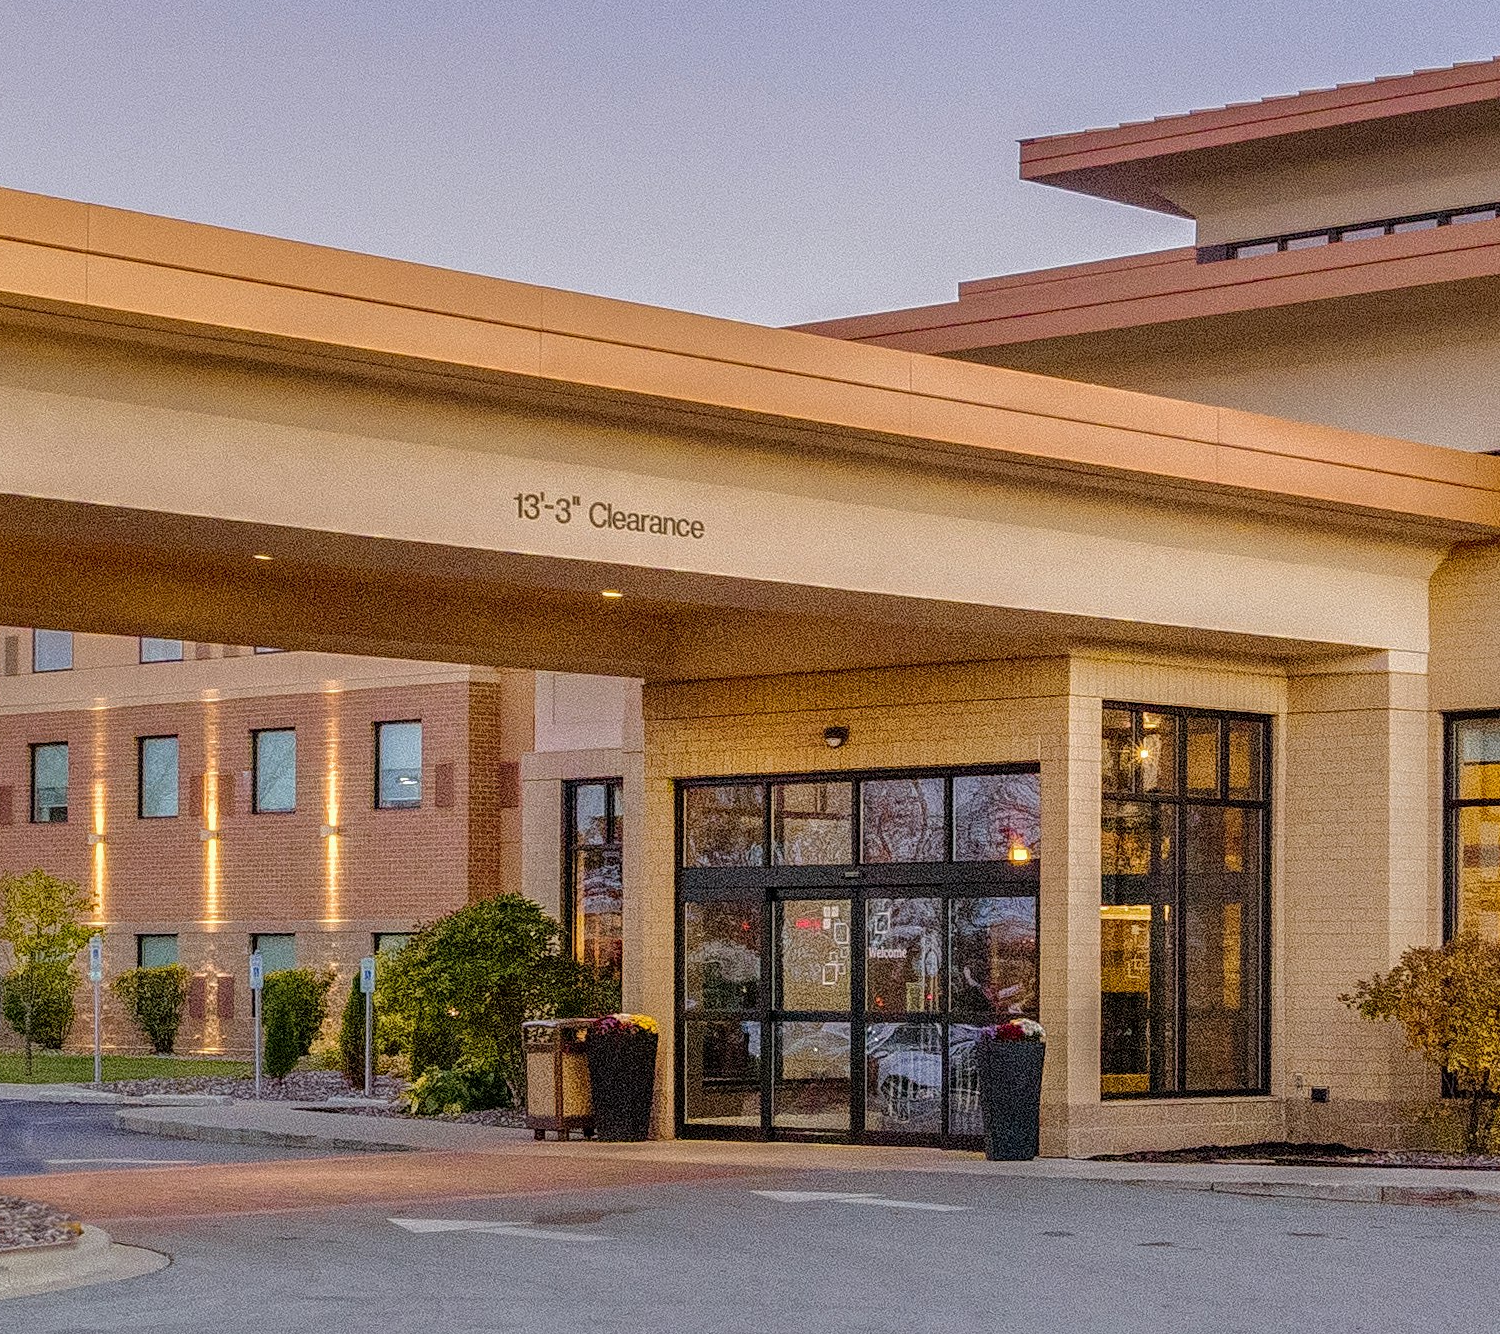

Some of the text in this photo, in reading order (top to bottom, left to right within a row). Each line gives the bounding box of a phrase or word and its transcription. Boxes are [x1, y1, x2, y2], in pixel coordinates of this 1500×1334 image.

[513, 491, 705, 539] 13'-3" Clearance
[868, 946, 908, 959] Welcome
